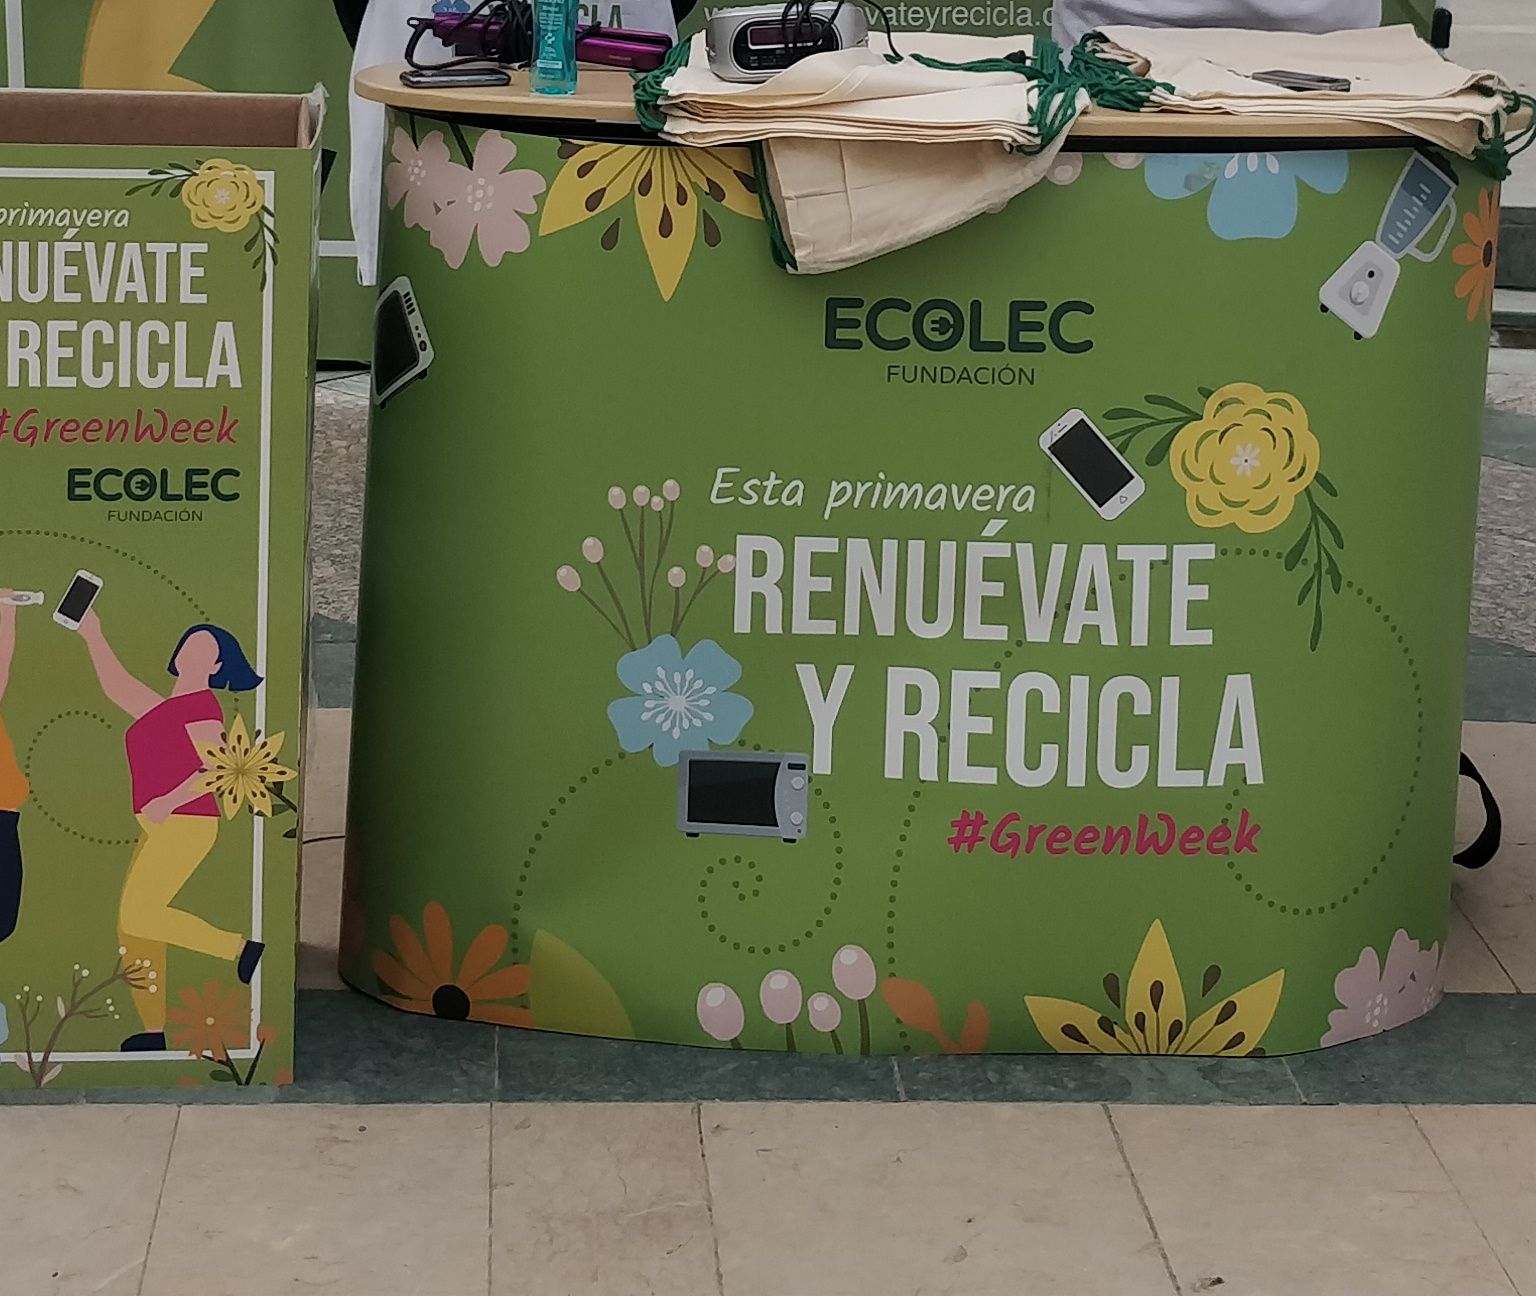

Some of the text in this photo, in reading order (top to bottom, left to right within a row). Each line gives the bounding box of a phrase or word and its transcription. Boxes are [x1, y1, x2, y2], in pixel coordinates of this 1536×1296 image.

[823, 296, 1095, 355] ECOLEC
[7, 319, 242, 389] RECICLA
[885, 362, 1036, 386] FUNDACIÓN
[66, 467, 241, 502] ECOLEC
[709, 466, 1036, 520] Esta primavera
[107, 508, 203, 523] FUNDACIÓN
[732, 519, 1216, 647] RENUÉVATE
[795, 662, 1265, 789] Y RECICLA
[946, 808, 1261, 860] #GreenWeek
